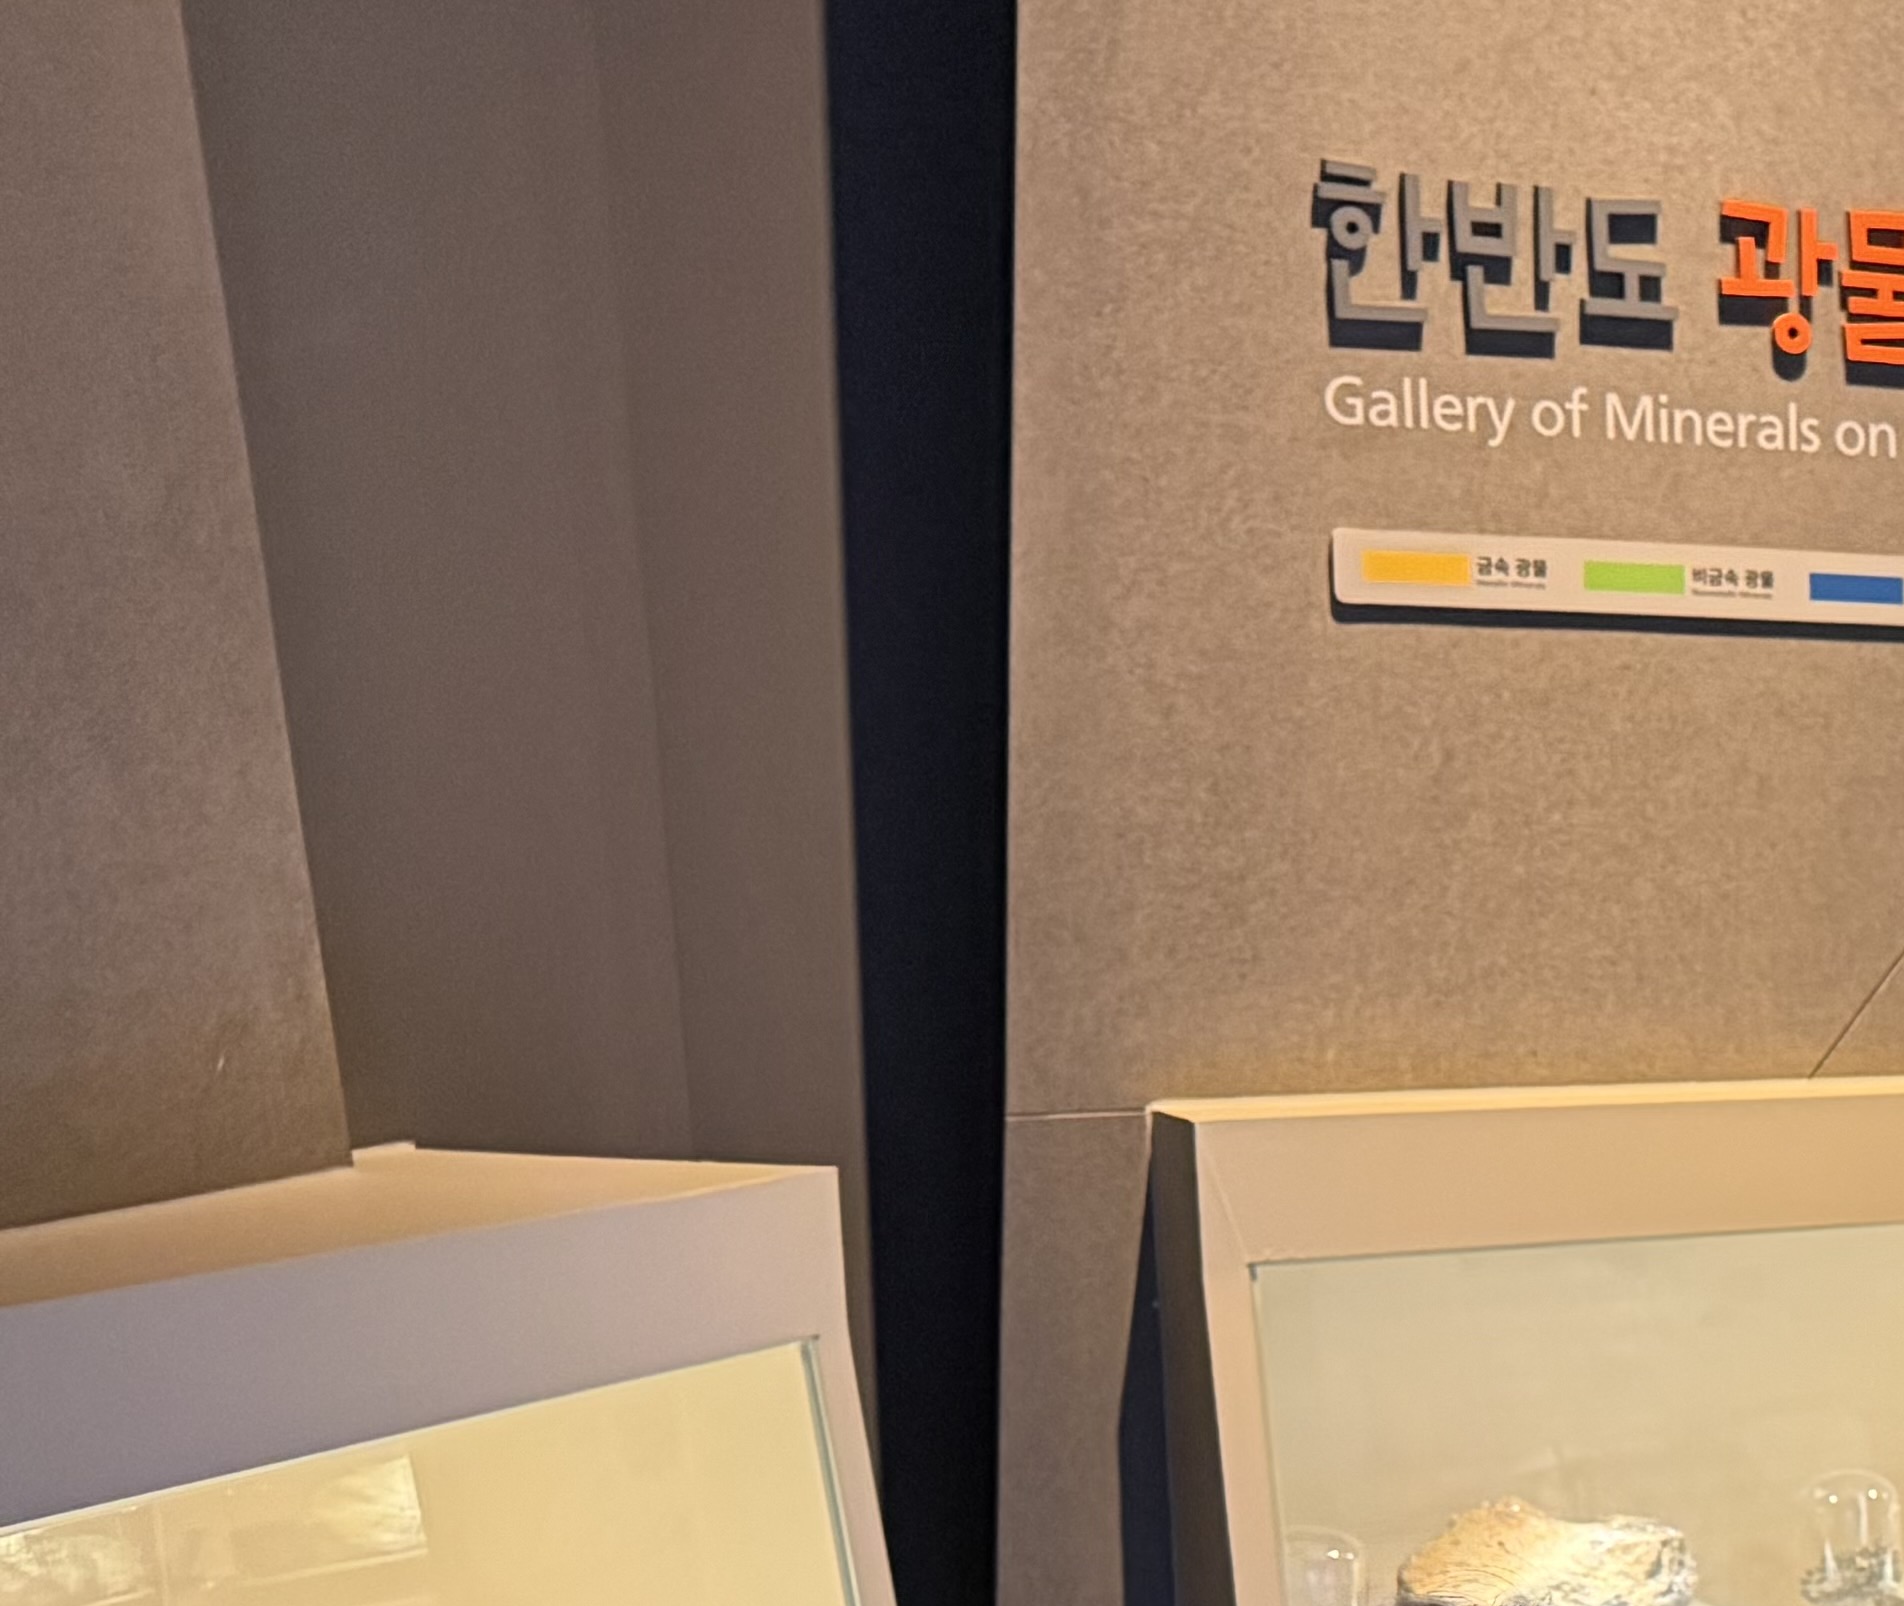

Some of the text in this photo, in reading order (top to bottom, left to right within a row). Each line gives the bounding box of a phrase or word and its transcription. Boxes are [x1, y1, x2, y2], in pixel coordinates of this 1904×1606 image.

[1313, 158, 1680, 336] 한반도
[1323, 375, 1516, 448] Gallery
[1530, 386, 1590, 439] of
[1605, 391, 1822, 454] Minerals
[1834, 418, 1898, 459] on
[1476, 555, 1510, 578] 금속
